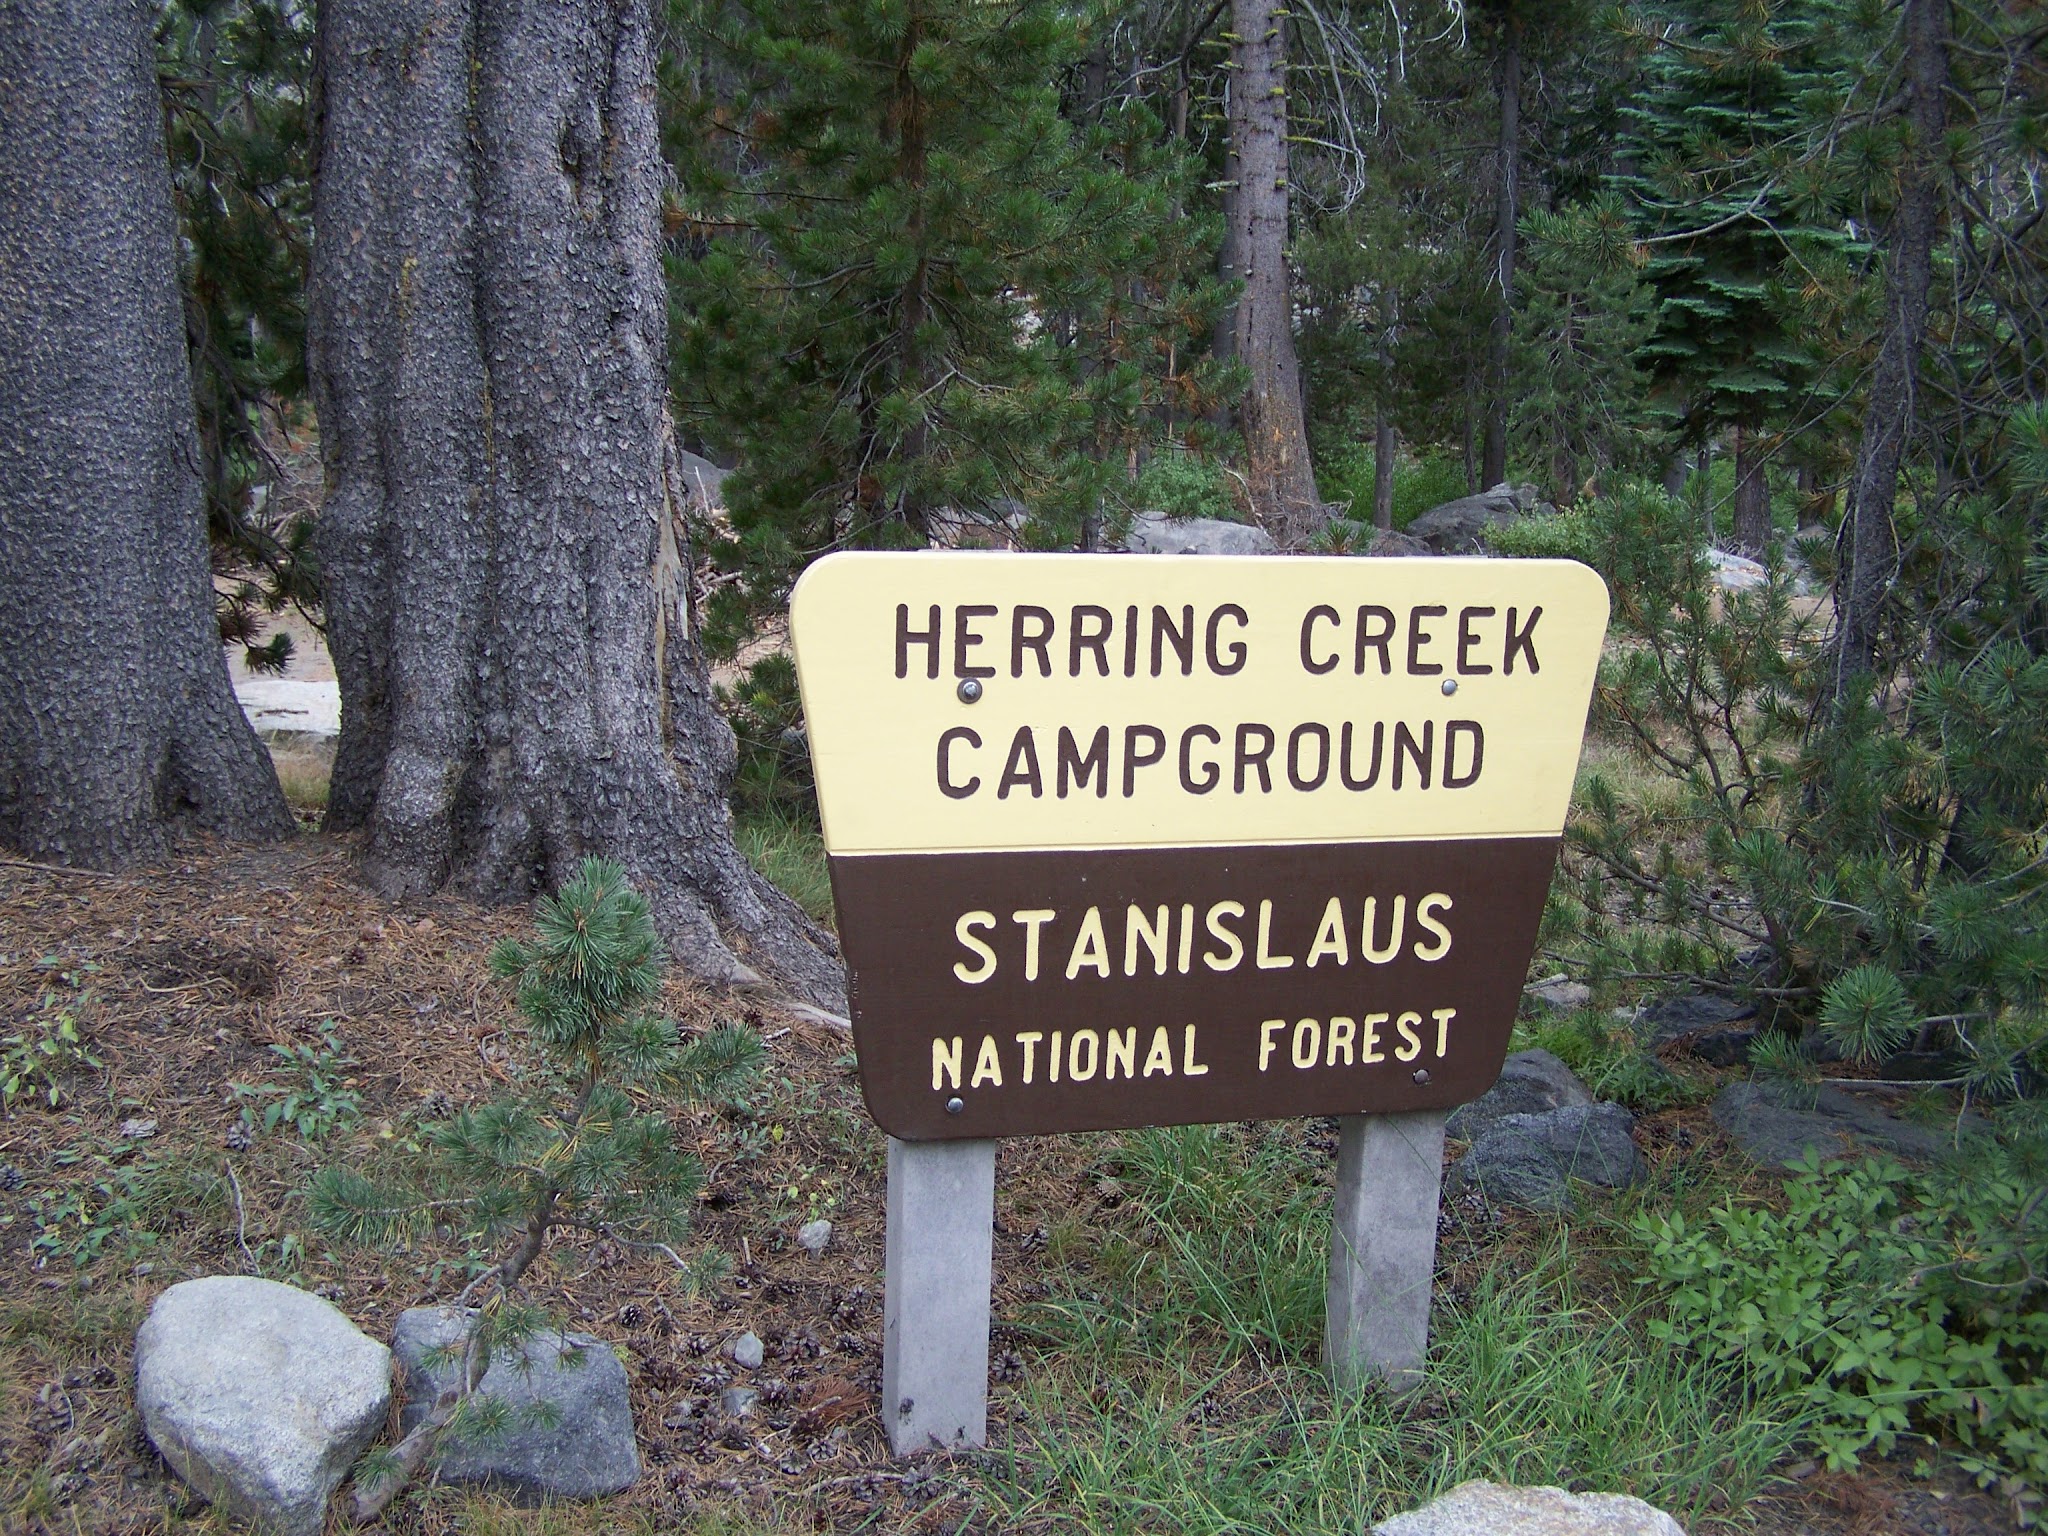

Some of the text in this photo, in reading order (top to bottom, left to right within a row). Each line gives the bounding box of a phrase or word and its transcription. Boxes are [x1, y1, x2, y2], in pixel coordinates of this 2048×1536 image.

[894, 603, 1545, 680] HERRING CREEK
[936, 719, 1485, 801] CAMPGROUND
[952, 892, 1453, 985] STANISLAUS
[931, 1008, 1457, 1091] NATIONAL FOREST
